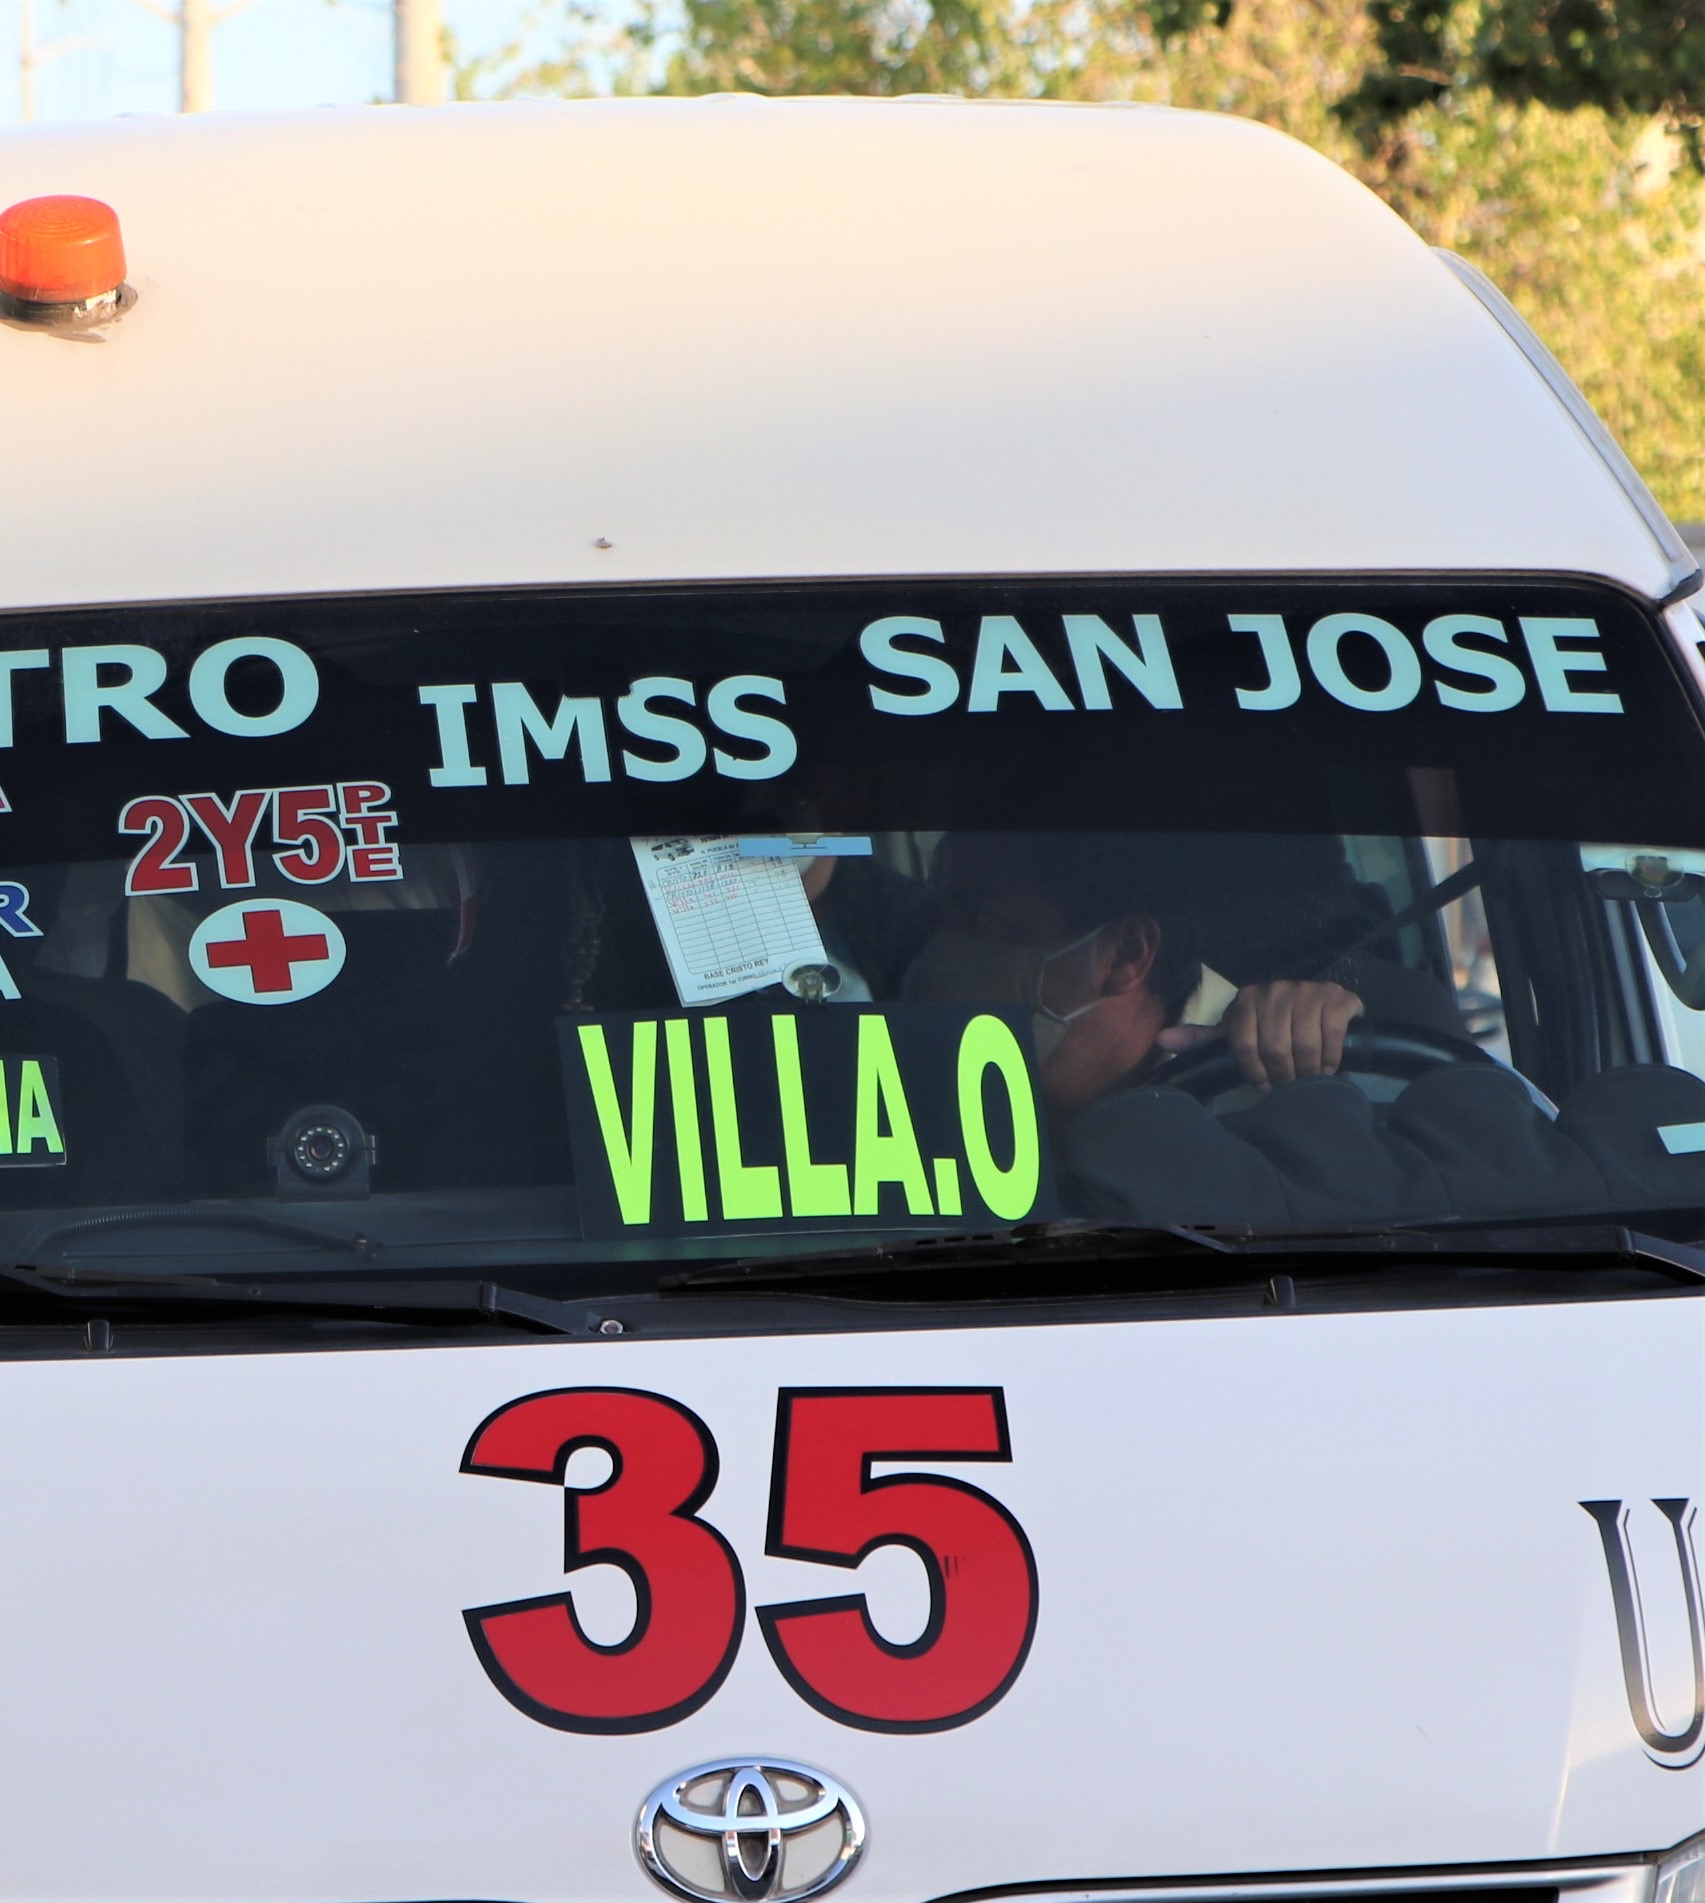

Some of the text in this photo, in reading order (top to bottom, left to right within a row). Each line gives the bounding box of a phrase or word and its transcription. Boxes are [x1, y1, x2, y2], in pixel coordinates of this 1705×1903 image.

[860, 612, 1624, 716] SAN JOSE
[419, 675, 798, 787] IMSS
[118, 786, 348, 896] 2Y5
[704, 969, 724, 980] BASE
[726, 962, 753, 975] CRISTO
[754, 959, 769, 969] REY
[577, 1014, 1040, 1226] VILLA.O
[459, 1386, 1039, 1735] 35
